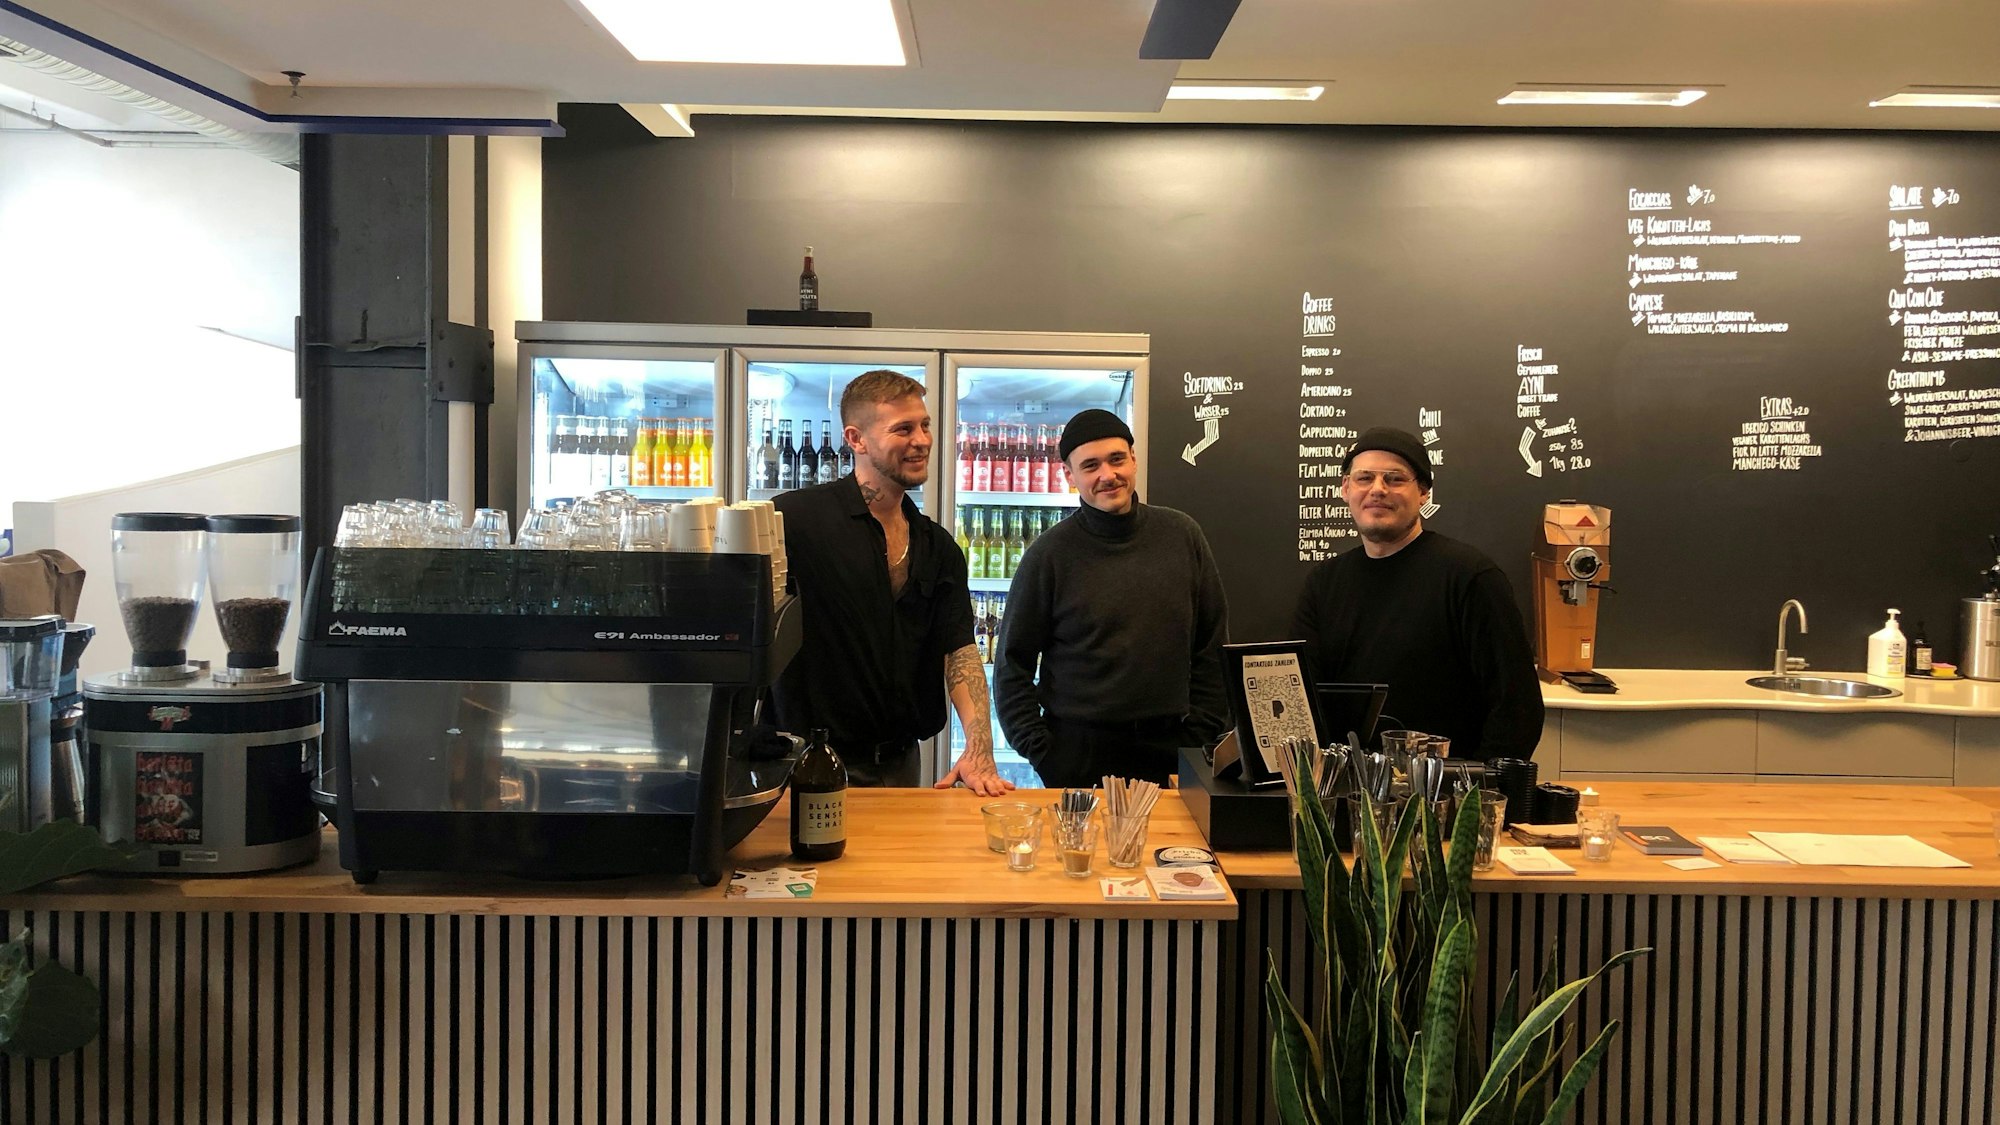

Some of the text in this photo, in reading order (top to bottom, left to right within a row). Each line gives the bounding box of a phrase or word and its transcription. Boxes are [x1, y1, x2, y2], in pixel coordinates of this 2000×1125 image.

[1629, 189, 1671, 207] FOCACCIAS
[1628, 219, 1643, 234] VEG
[1628, 254, 1675, 271] MANCHEGO
[1302, 292, 1334, 314] COFFEE
[1629, 293, 1664, 311] CAPRESE
[1303, 315, 1336, 335] DRINKS
[1301, 345, 1329, 358] ESPRESSO
[1301, 365, 1322, 376] DOPPIO
[1184, 371, 1233, 395] SOFTDRINKS
[1518, 375, 1544, 395] AYNI
[1888, 369, 1946, 390] GREENTHUMB
[1301, 383, 1341, 398] AMERICANO
[1203, 393, 1213, 404] &
[1194, 404, 1221, 419] WASSER
[1300, 403, 1335, 418] CORTADO
[1517, 404, 1541, 418] COFFEE
[1760, 396, 1793, 418] EXTRAS
[1419, 407, 1442, 428] CHILI
[1300, 424, 1346, 439] CAPPUCCINO
[1770, 421, 1806, 433] SCHINKEN
[1422, 428, 1438, 443] SIN
[1299, 444, 1334, 458] DOPPELTER
[1428, 449, 1444, 466] RNE
[1749, 446, 1758, 457] DI
[1758, 445, 1780, 457] LATTE
[1780, 445, 1822, 457] MOZZARELLA
[1299, 463, 1343, 479] FLAT WHITE
[1549, 456, 1566, 472] 1kg
[1732, 456, 1802, 471] MANCHEGO-KÄSE
[1299, 484, 1324, 499] LATTE
[1299, 504, 1322, 520] FILTER
[1323, 526, 1347, 538] KAKAO
[1298, 538, 1317, 551] CHAI
[1311, 550, 1325, 562] TEE
[347, 625, 407, 637] FAEMA
[629, 632, 721, 642] Ambassador
[808, 801, 842, 810] BLACK
[809, 811, 843, 820] SENSE
